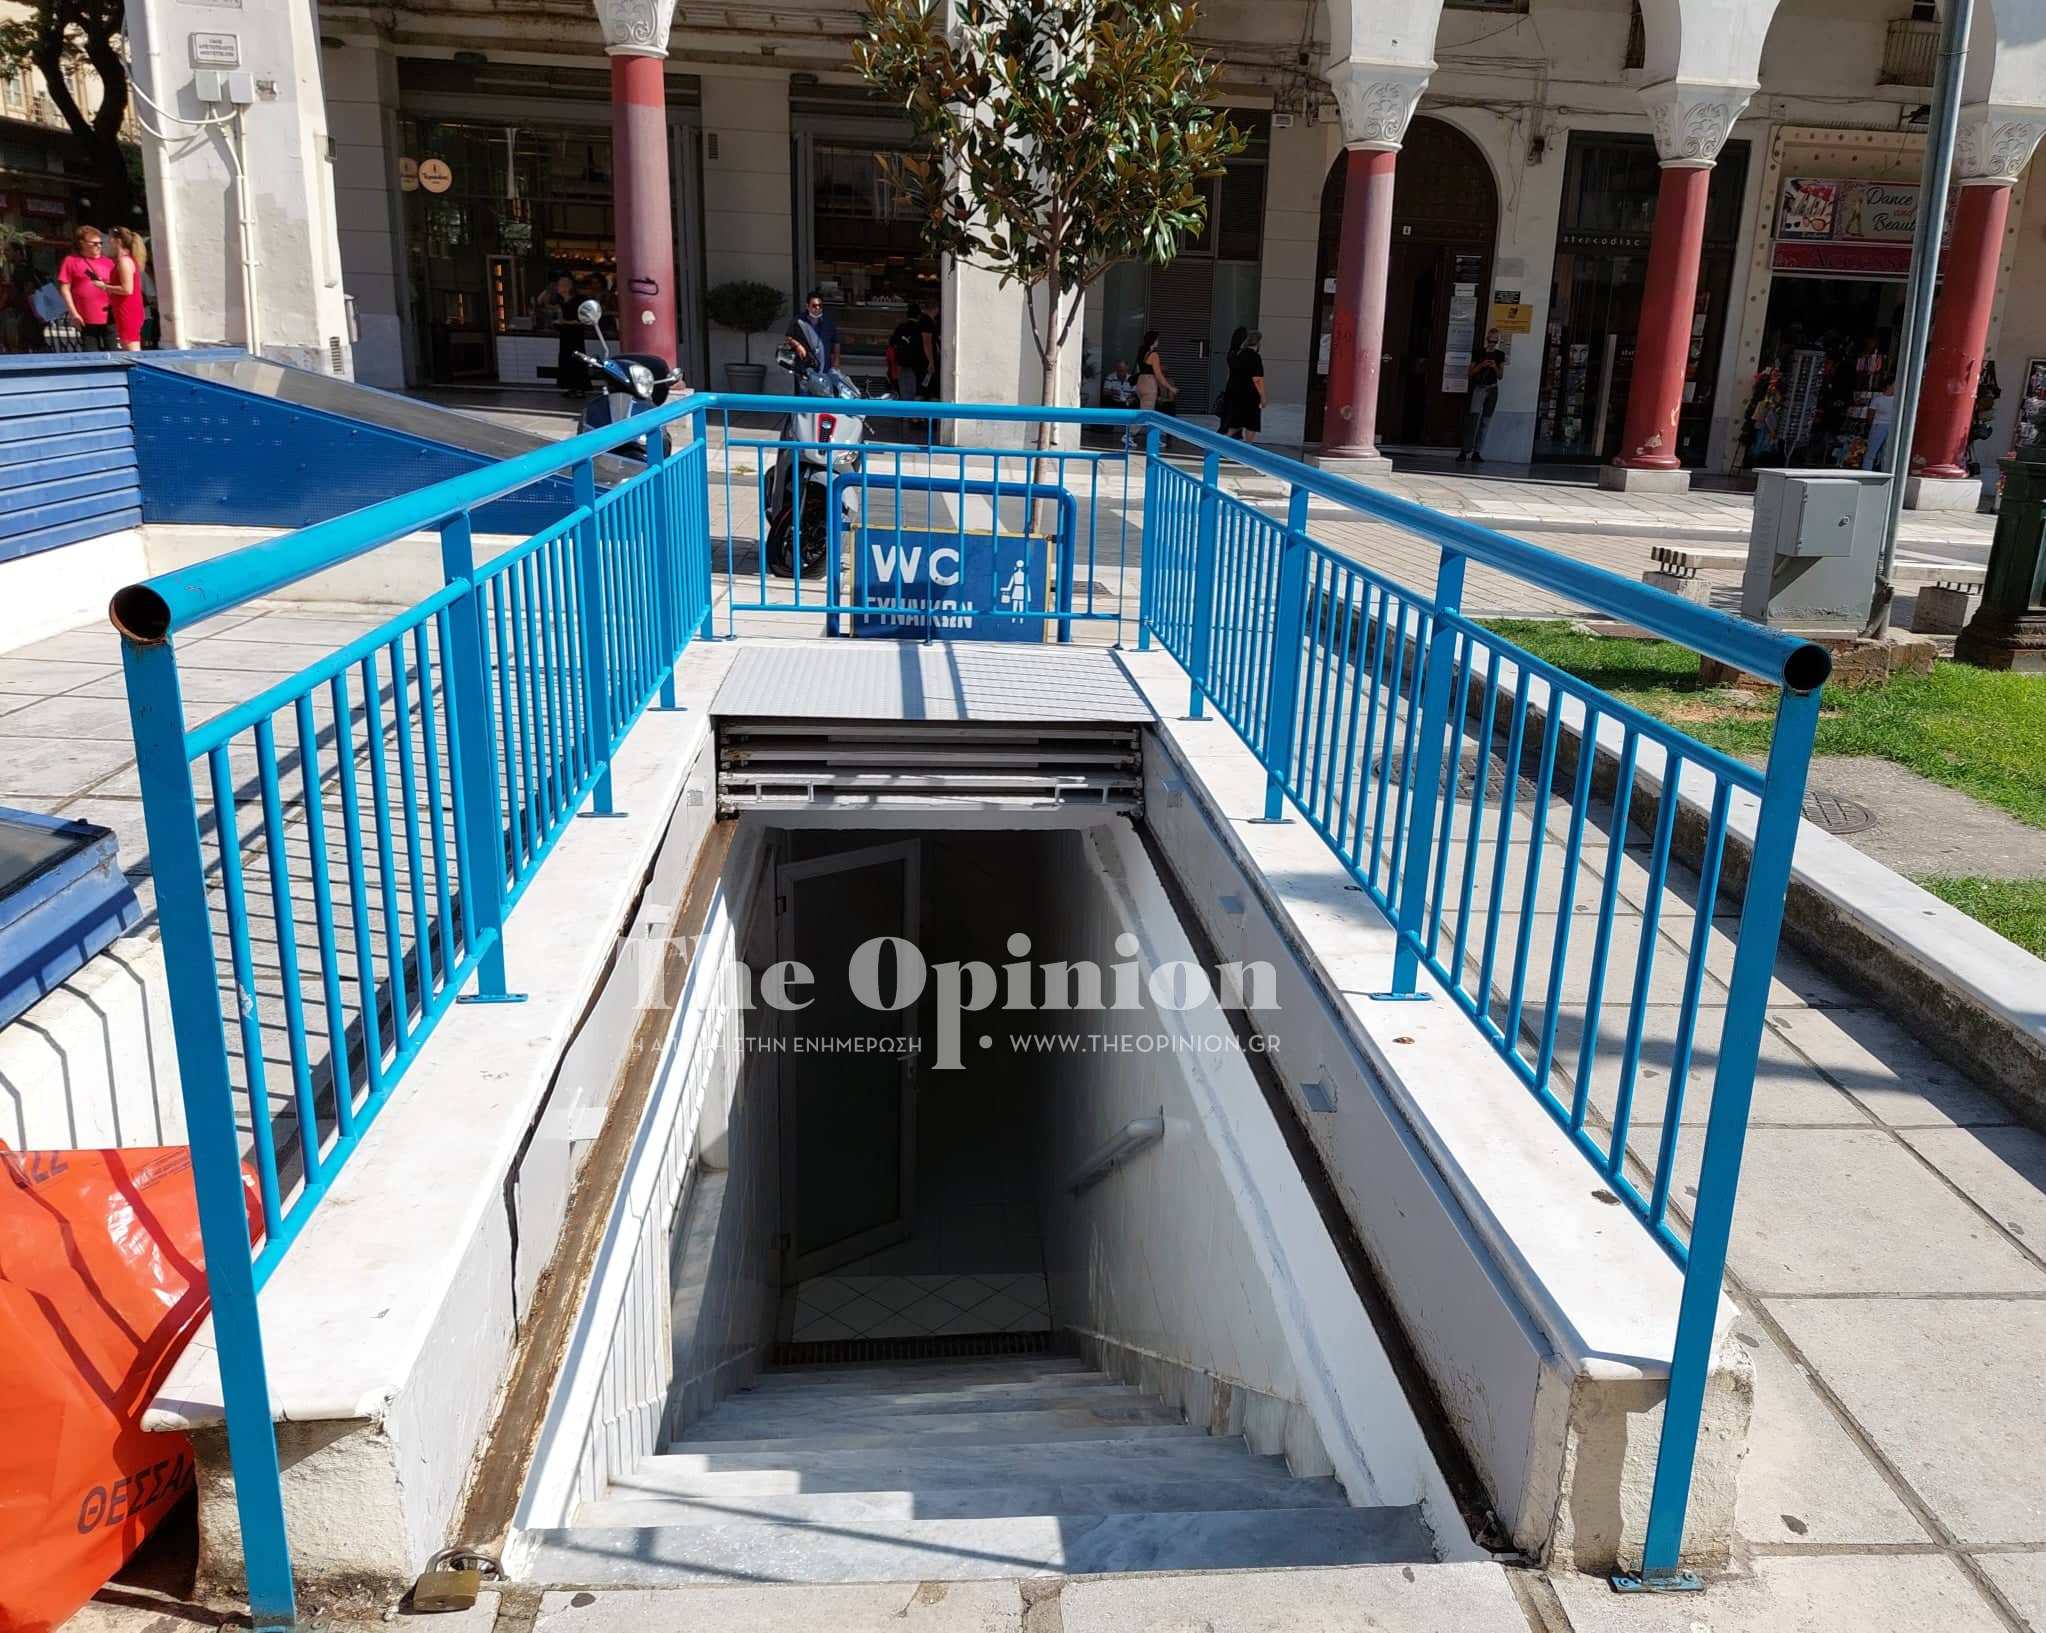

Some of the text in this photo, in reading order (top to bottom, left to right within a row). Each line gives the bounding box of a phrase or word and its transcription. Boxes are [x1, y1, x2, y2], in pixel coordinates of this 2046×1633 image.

[1866, 186, 1914, 206] Dance
[1872, 213, 1916, 232] Beaut
[1563, 234, 1641, 247] stereodisc
[872, 544, 961, 586] WC
[864, 597, 973, 629] ΓΥΝΑΙΚΩΝ
